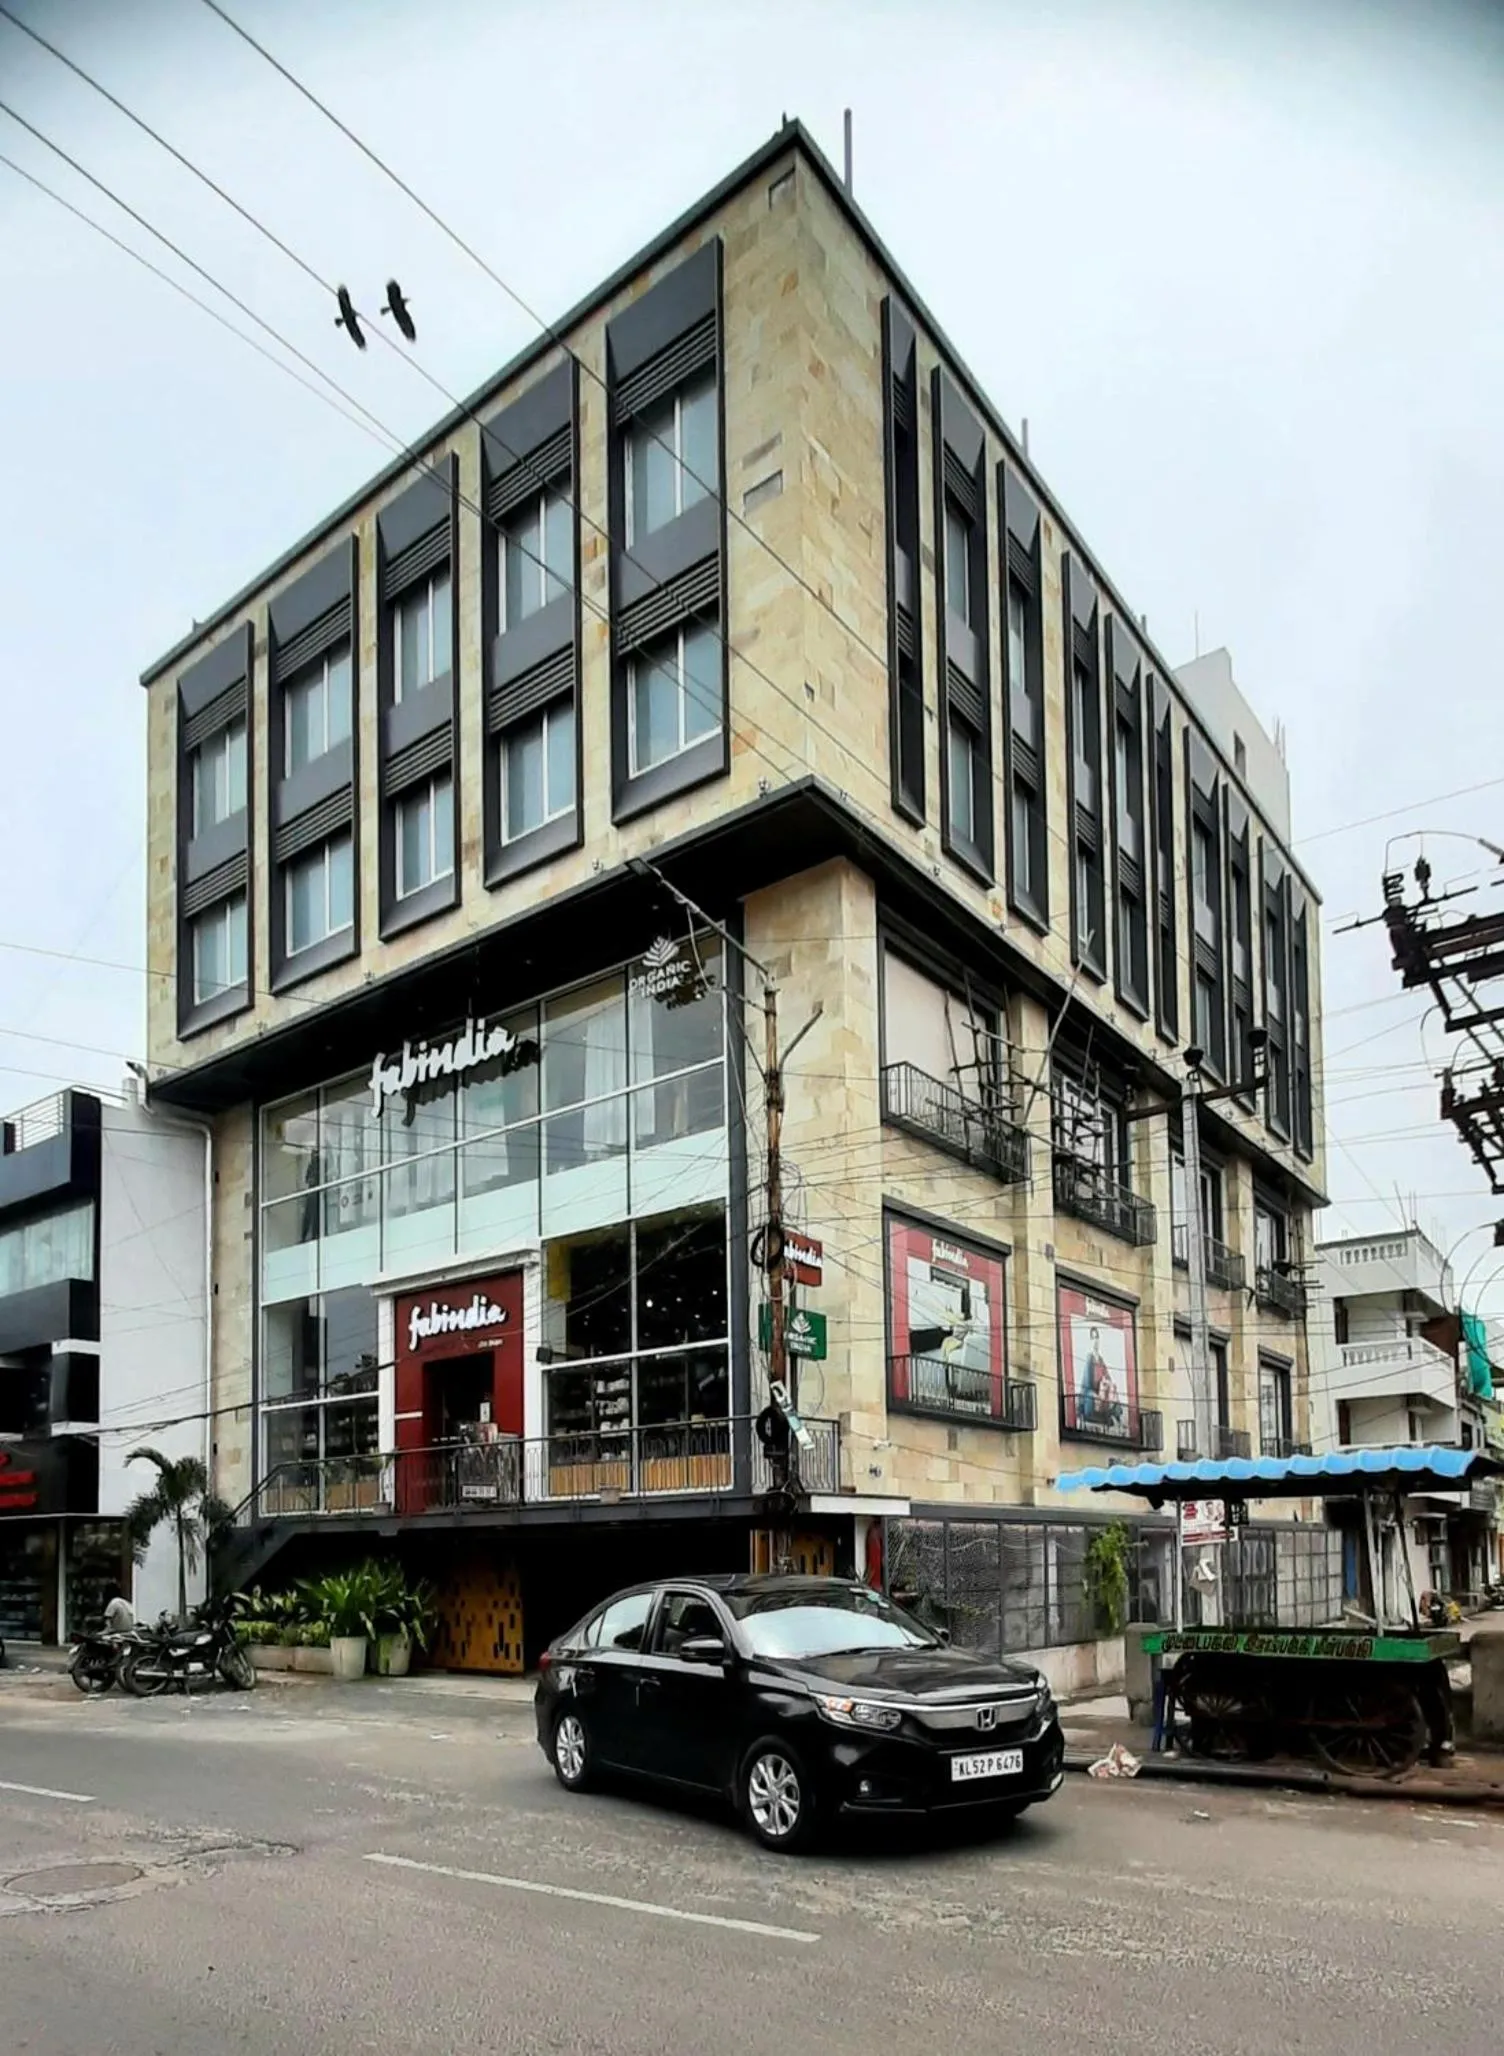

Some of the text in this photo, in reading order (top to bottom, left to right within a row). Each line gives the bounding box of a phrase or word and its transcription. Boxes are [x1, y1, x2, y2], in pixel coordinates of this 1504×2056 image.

[629, 960, 692, 989] ORGANIC
[640, 975, 681, 998] INDIA
[368, 1018, 515, 1118] fabindia
[408, 1294, 506, 1350] fabindia
